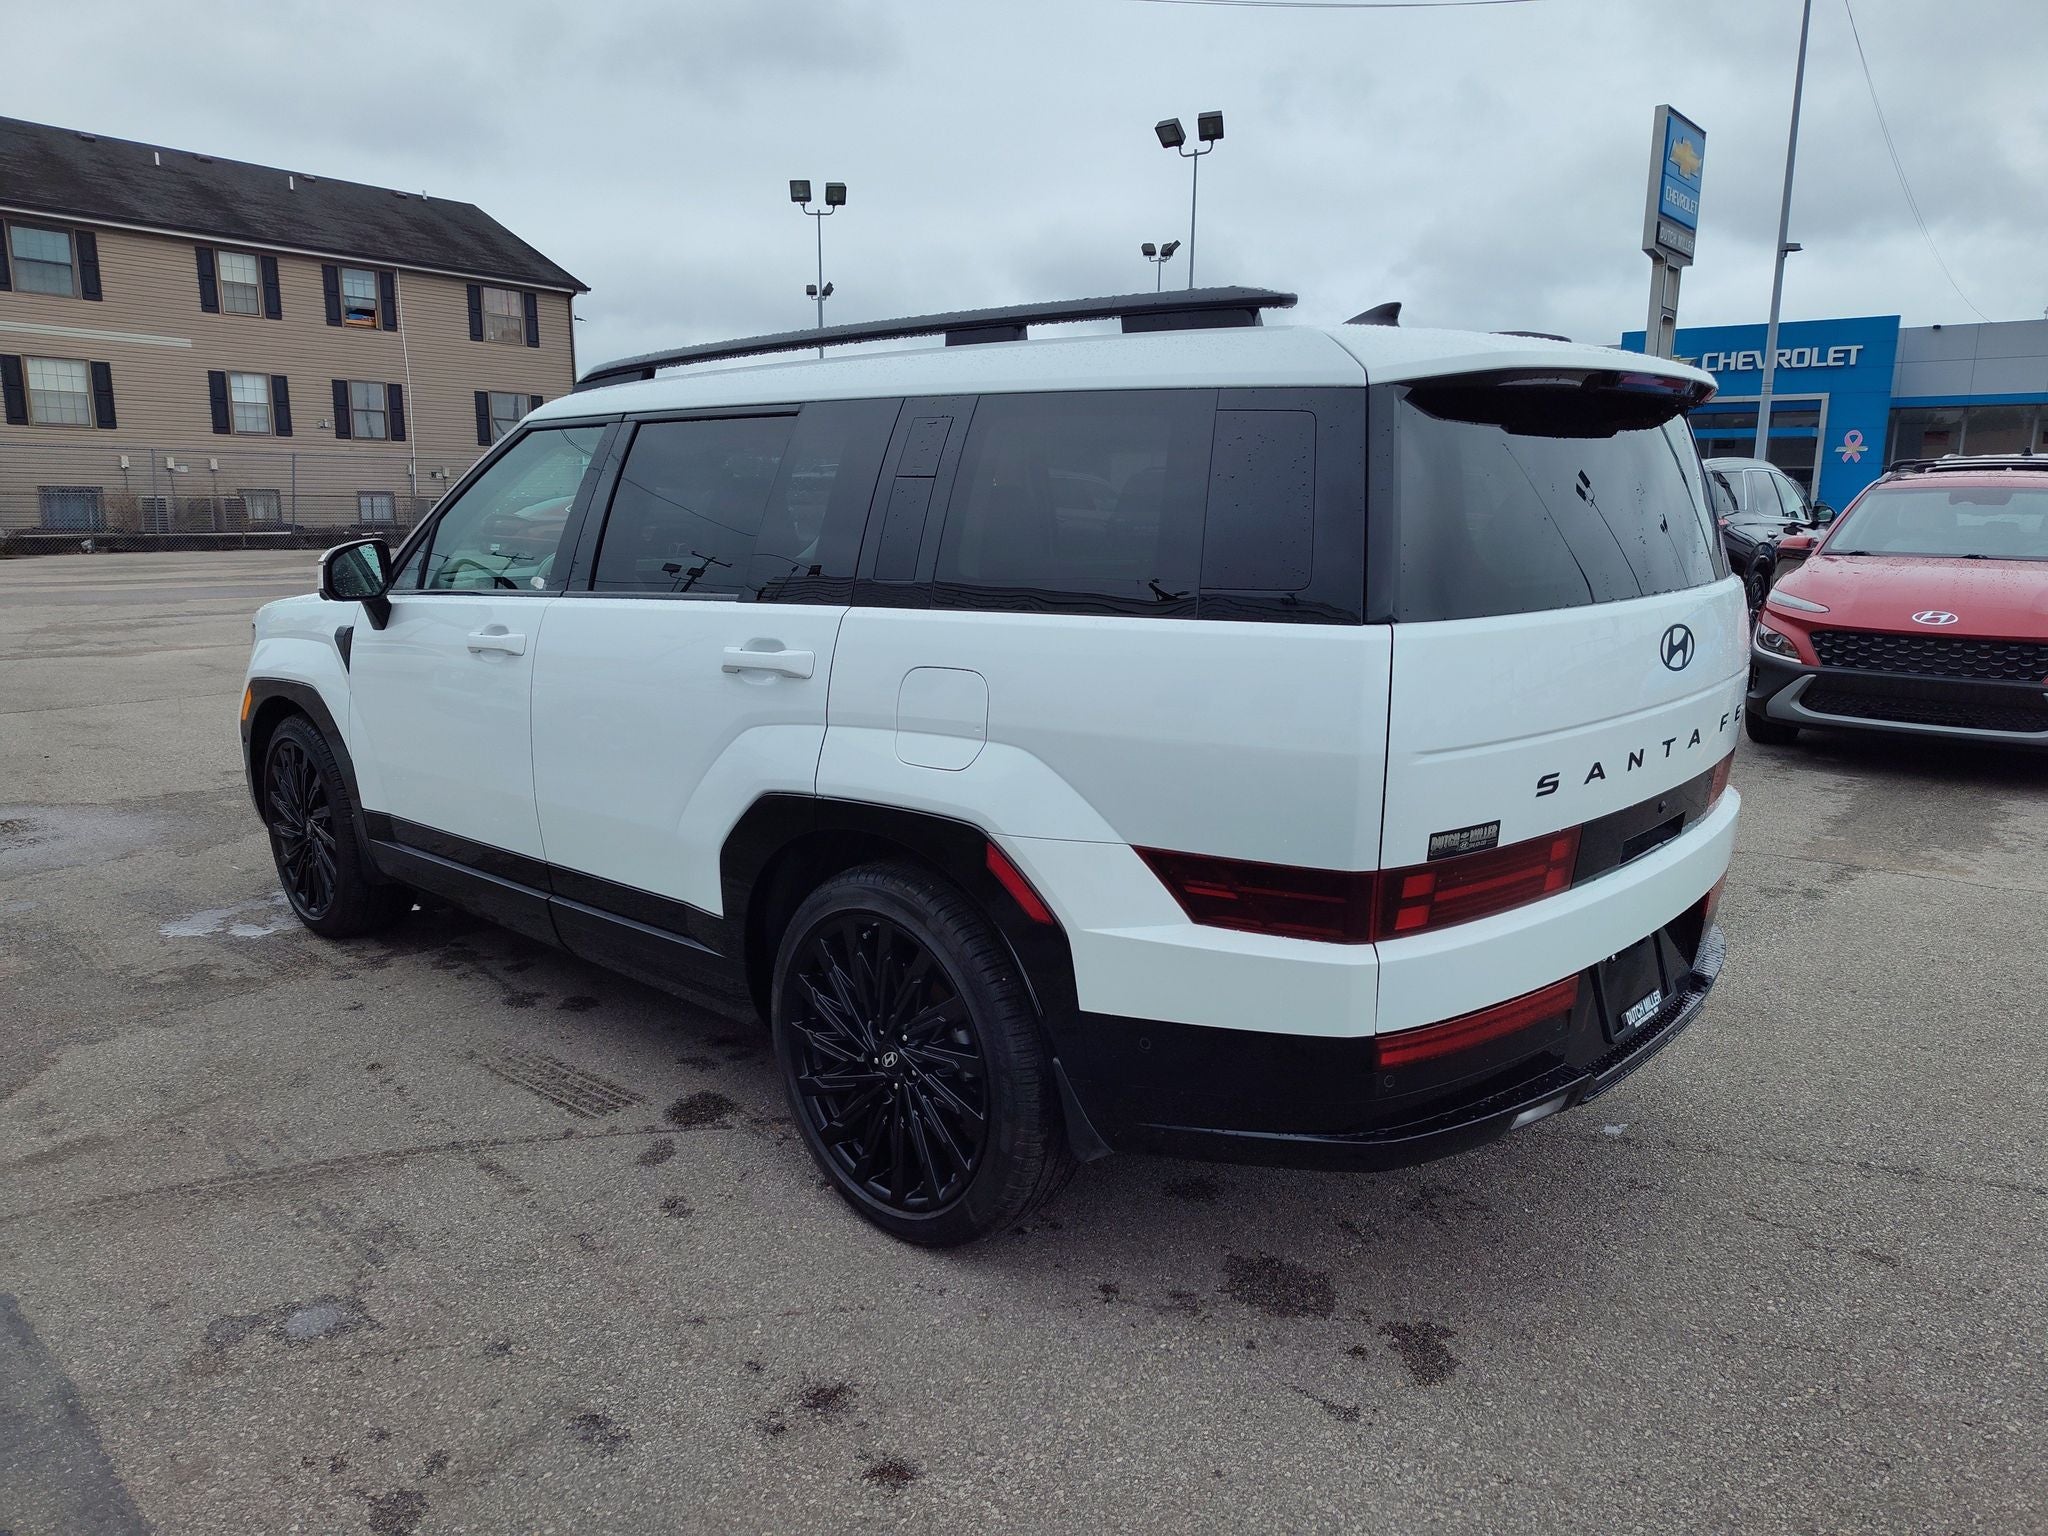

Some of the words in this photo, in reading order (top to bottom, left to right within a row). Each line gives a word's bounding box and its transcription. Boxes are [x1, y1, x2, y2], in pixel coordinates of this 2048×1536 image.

[1665, 185, 1698, 215] CHEVROLET
[1701, 345, 1864, 372] CHEVROLET
[1535, 728, 1702, 797] SANTA
[1719, 703, 1742, 732] FE
